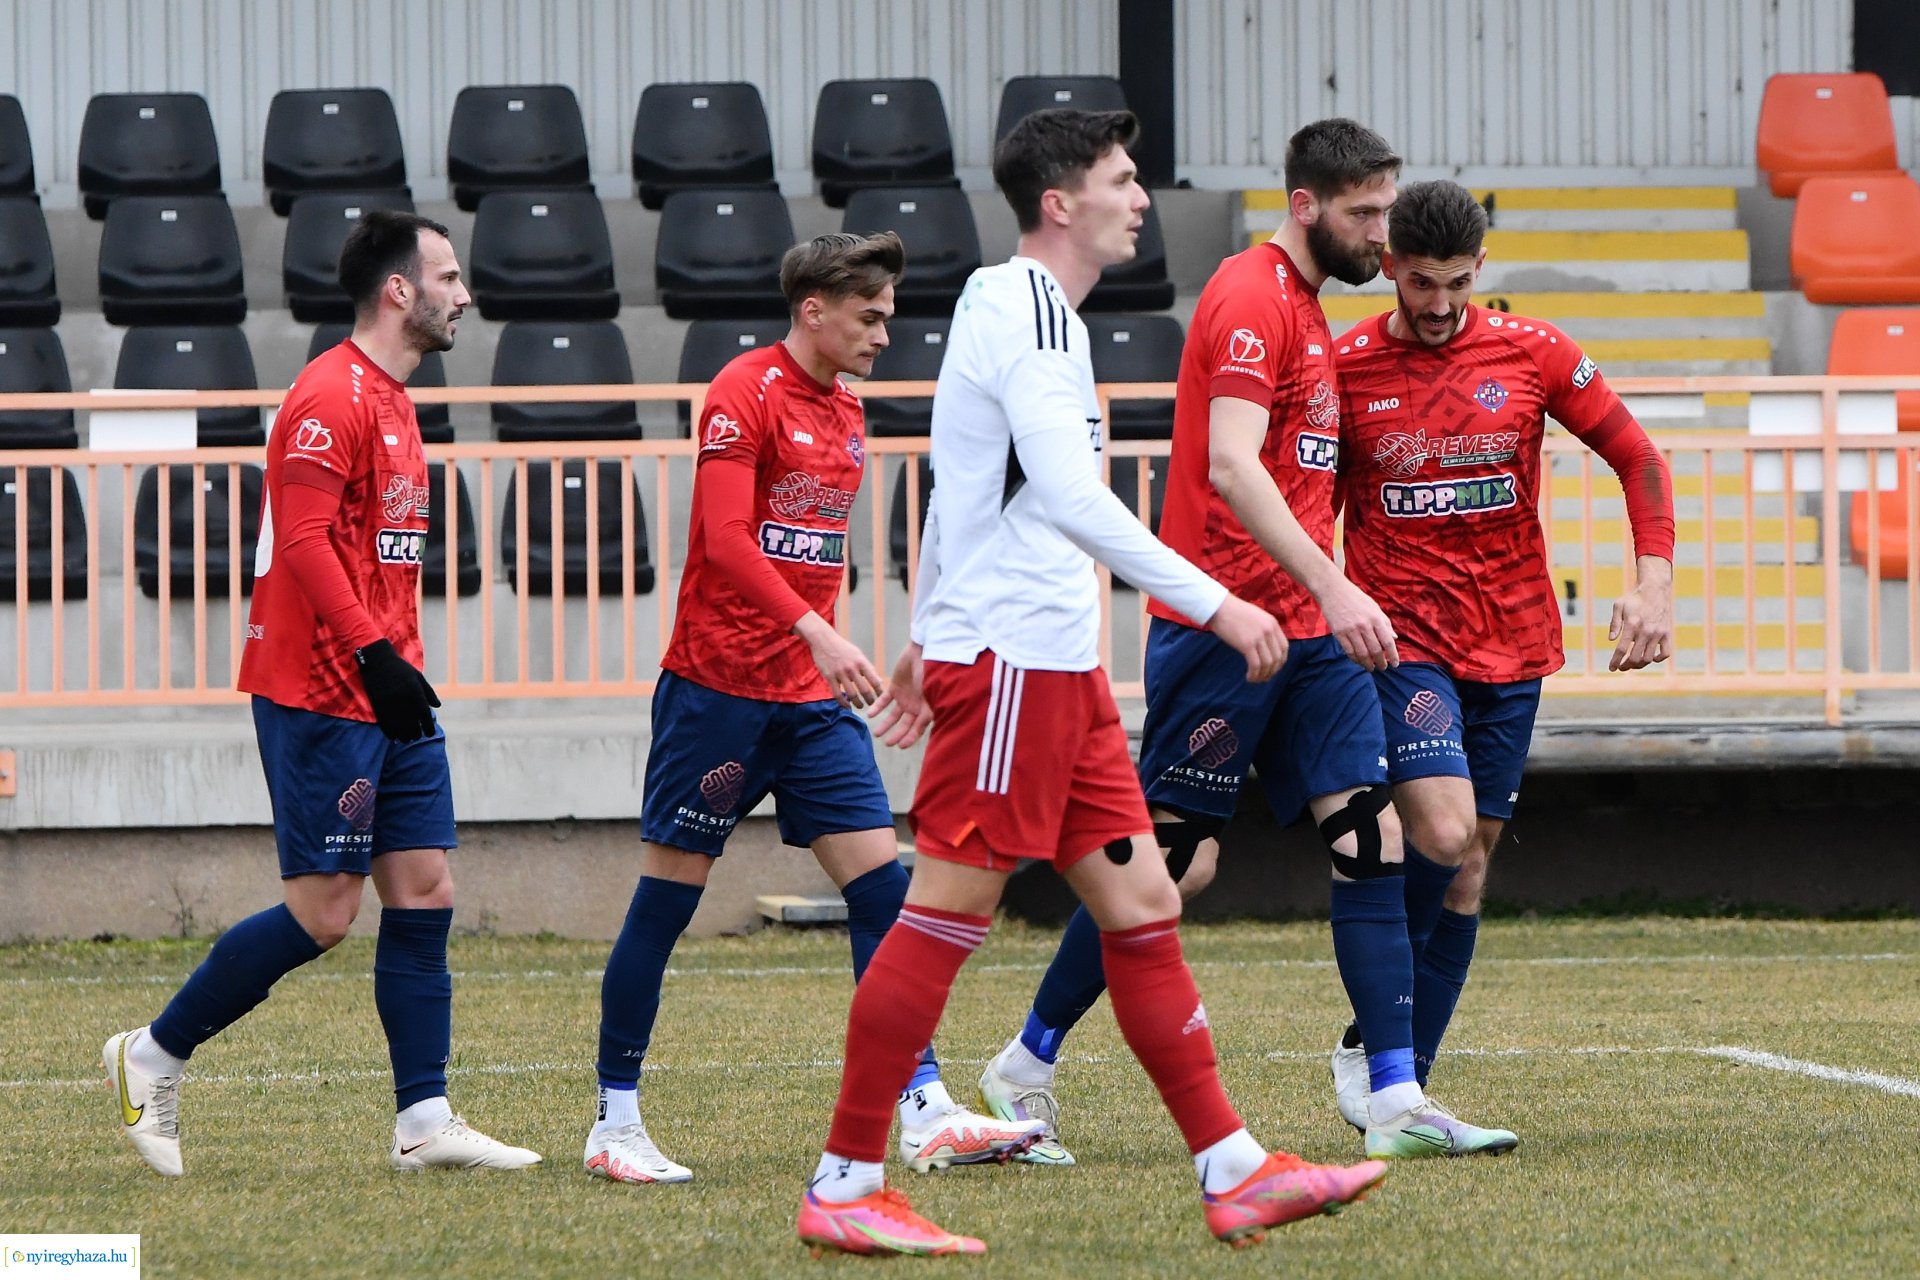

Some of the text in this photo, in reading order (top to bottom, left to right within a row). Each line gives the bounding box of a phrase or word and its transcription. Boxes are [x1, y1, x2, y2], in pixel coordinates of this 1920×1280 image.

[1367, 397, 1400, 413] JAKO
[1397, 739, 1462, 754] PRESTIG
[1395, 995, 1413, 1006] JA
